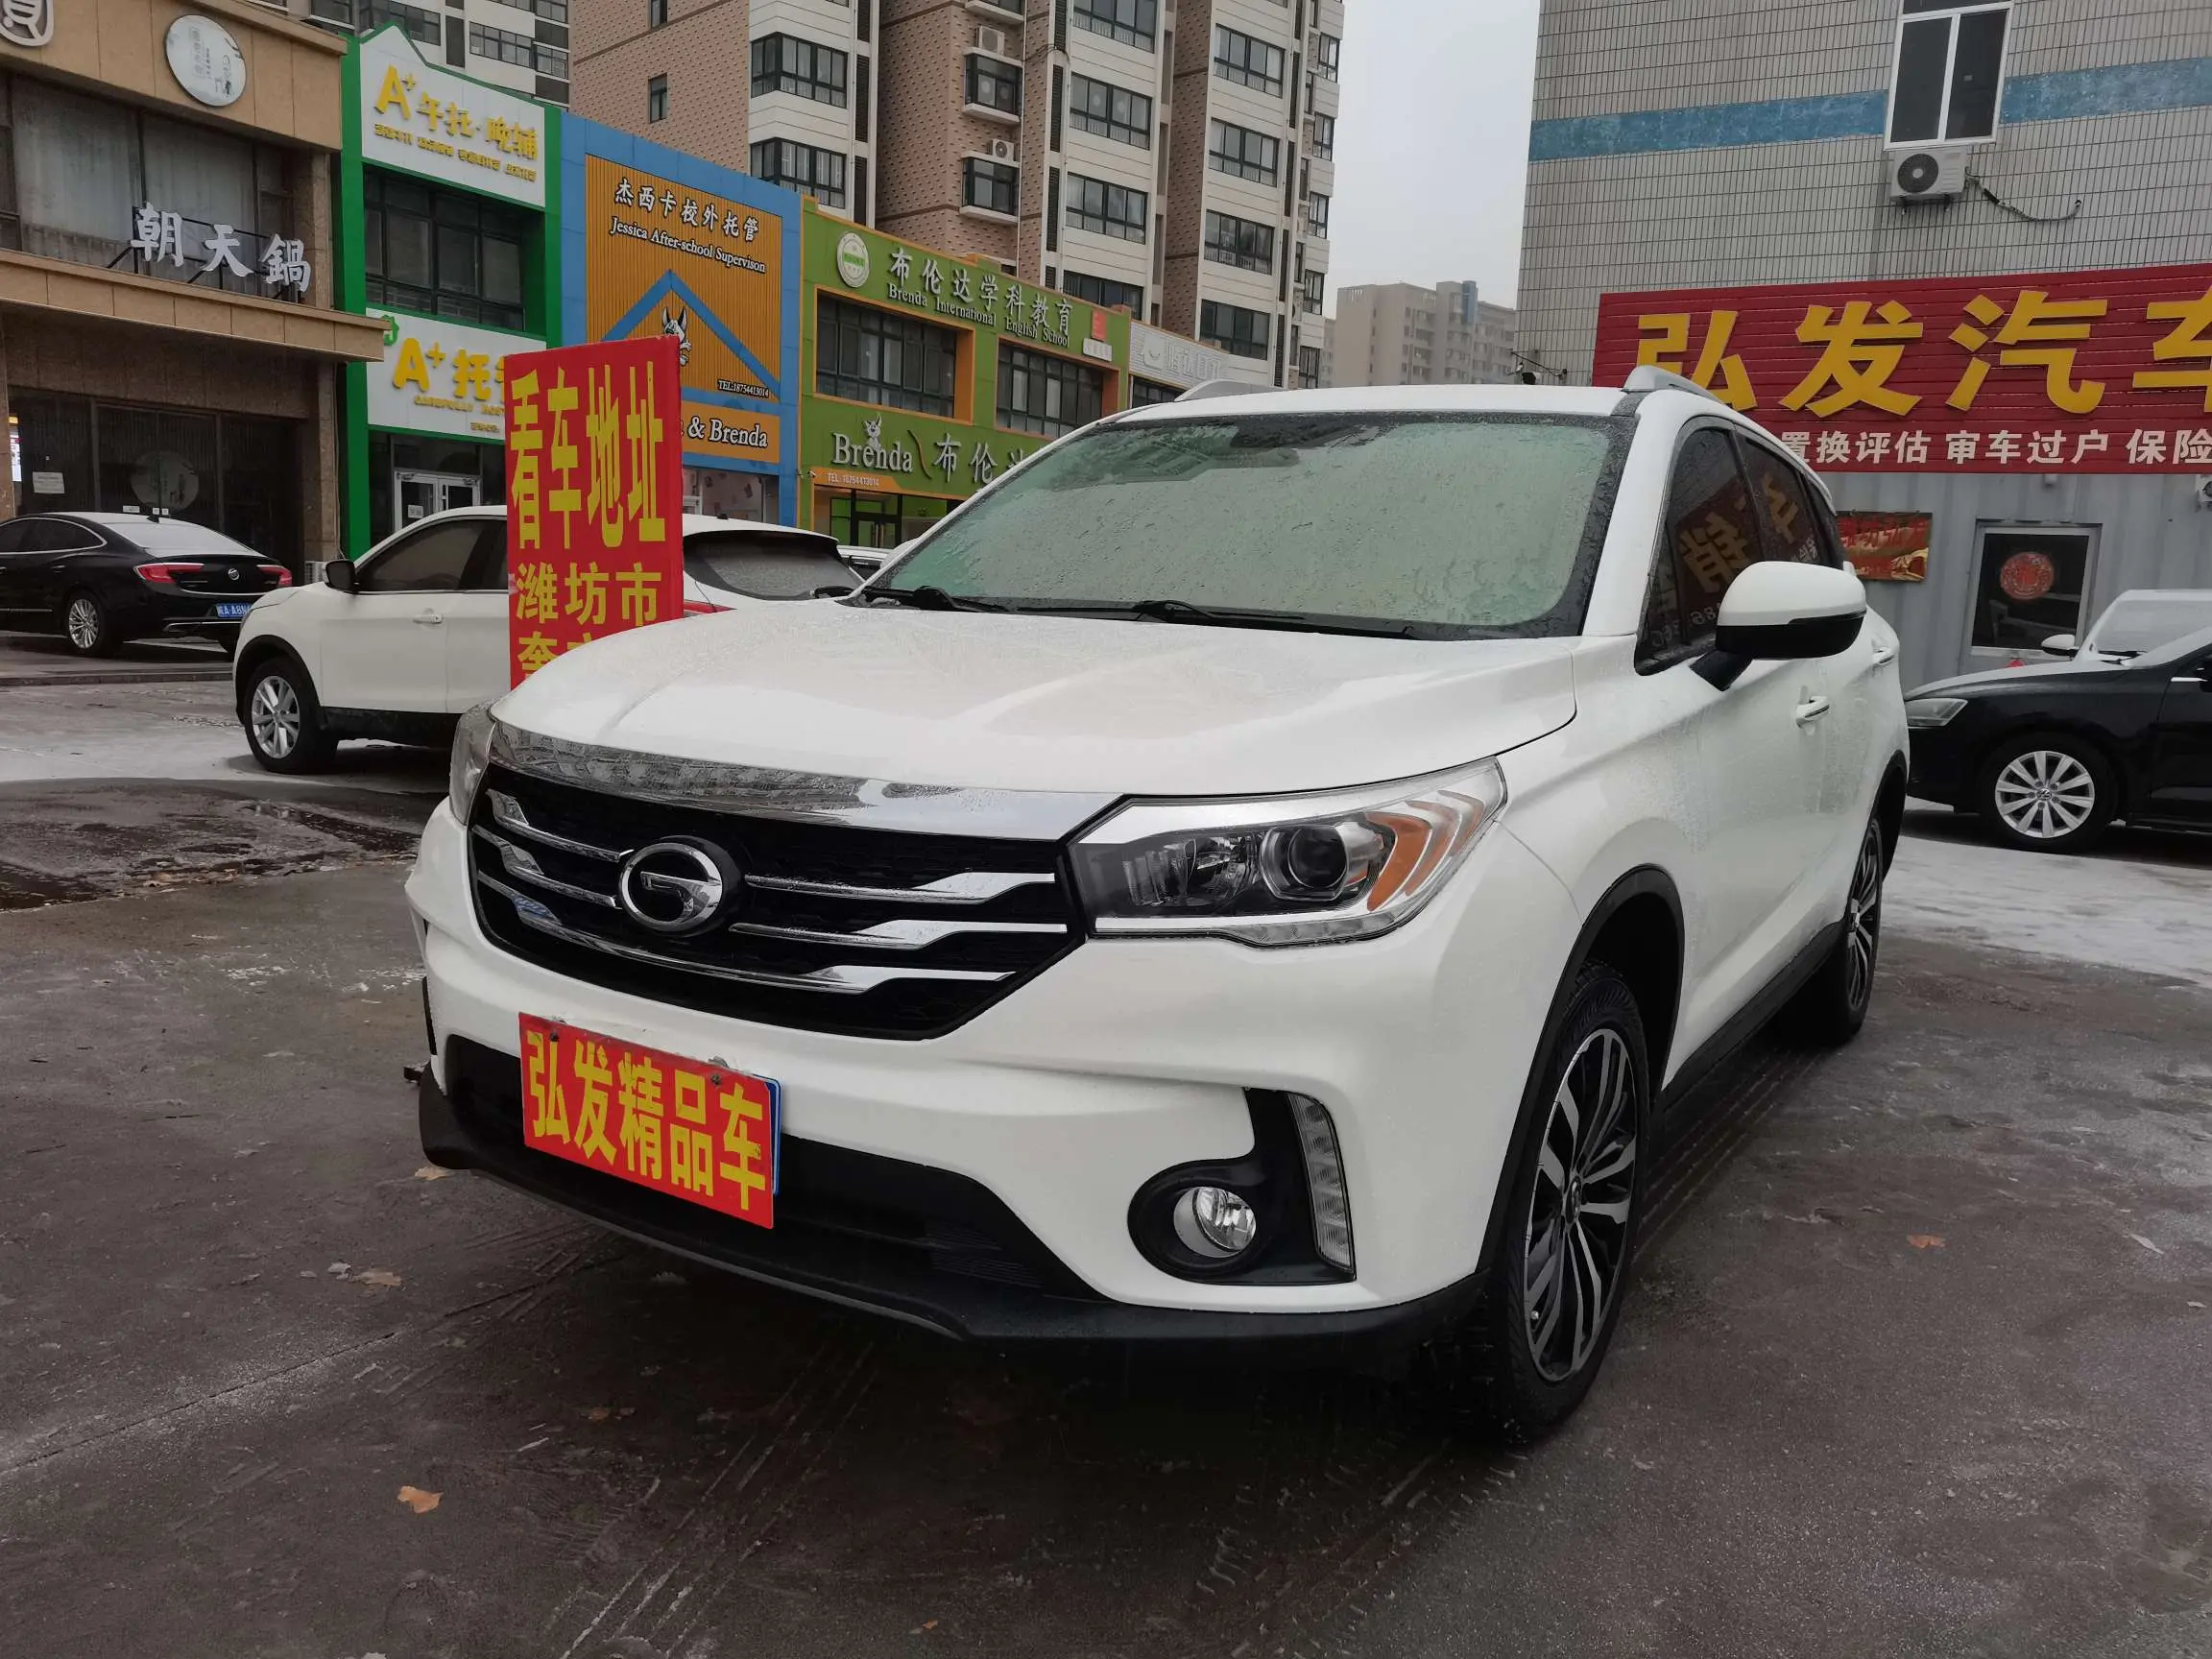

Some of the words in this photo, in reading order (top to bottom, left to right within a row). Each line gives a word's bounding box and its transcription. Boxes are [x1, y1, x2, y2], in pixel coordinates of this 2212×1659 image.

[614, 178, 759, 242] 杰西卡校外托管
[131, 202, 311, 292] 朝天鍋
[610, 216, 649, 240] Jessica
[650, 229, 714, 259] After-school
[715, 247, 766, 274] Supervison
[887, 282, 928, 307] Brenda
[936, 297, 997, 326] International
[1005, 315, 1038, 340] English
[1042, 327, 1070, 349] School
[889, 247, 1073, 338] 布伦达学科教育
[510, 361, 665, 550] 看车地址
[687, 415, 706, 440] &
[709, 418, 768, 447] Brenda
[831, 432, 913, 472] Brenda
[1780, 430, 1932, 465] 置换评估
[1945, 429, 2109, 465] 审车过户
[2125, 428, 2212, 465] 保险
[516, 561, 662, 626] 潍坊市
[527, 1030, 765, 1211] 弘发精品车
